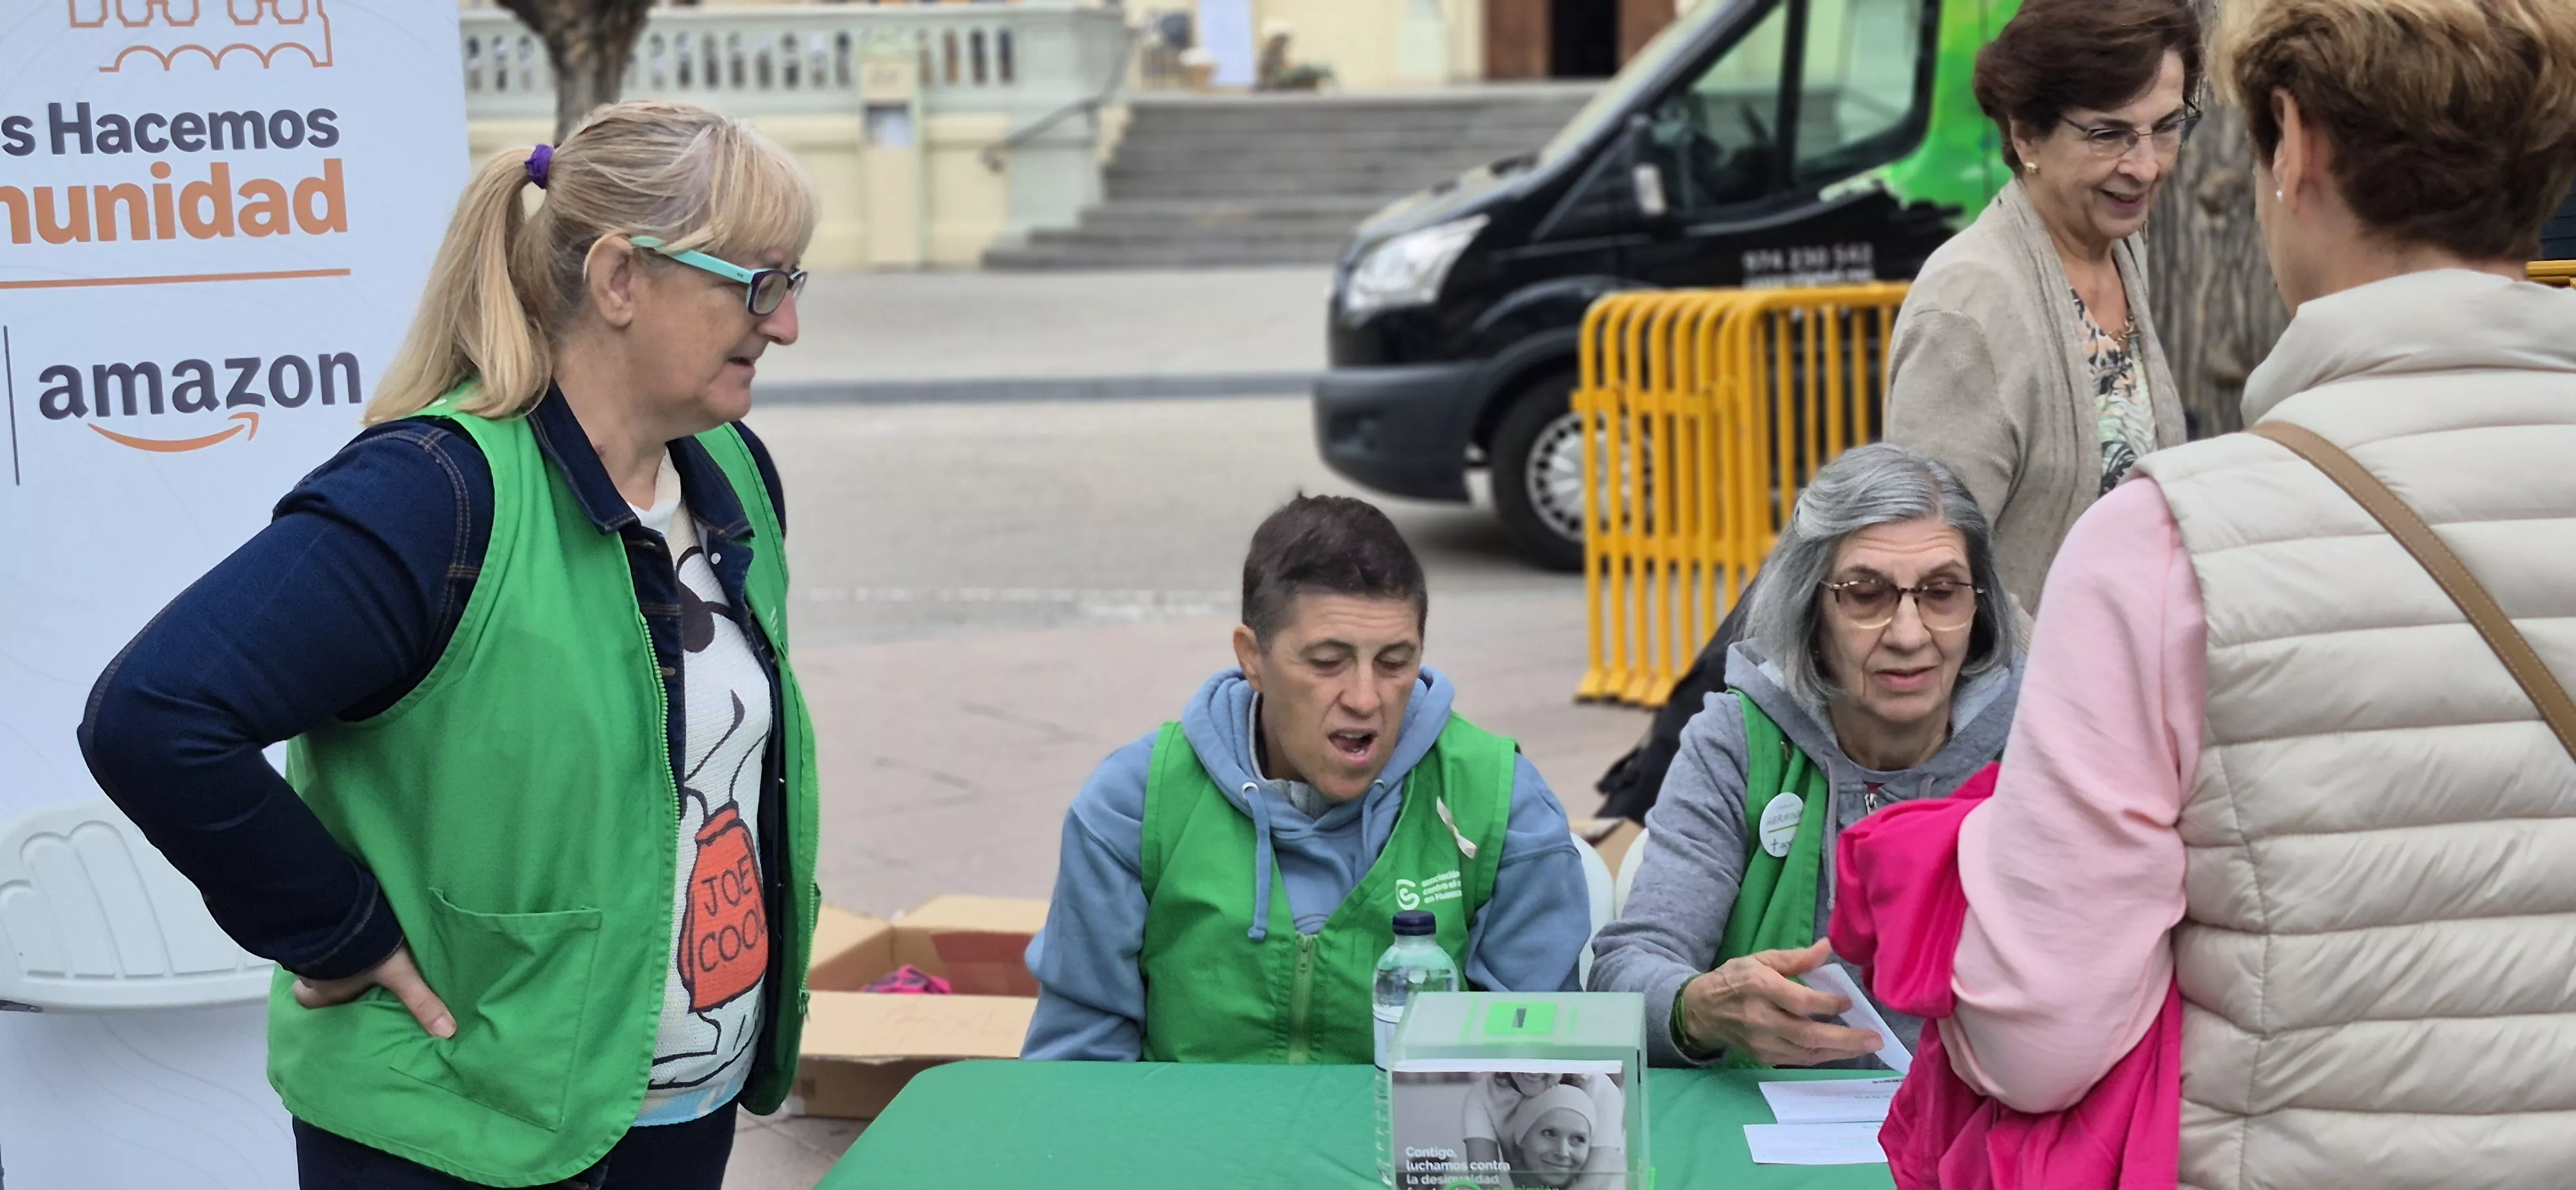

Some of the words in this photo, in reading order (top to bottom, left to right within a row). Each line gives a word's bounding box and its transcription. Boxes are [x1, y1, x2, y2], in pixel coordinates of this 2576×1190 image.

[48, 102, 341, 155] Hacemos
[39, 352, 363, 420] amazon
[701, 853, 752, 917] JOE
[1405, 1146, 1457, 1160] Contigo,
[1406, 1159, 1468, 1171] luchamos
[1470, 1160, 1510, 1171] contra
[1406, 1173, 1419, 1185] la
